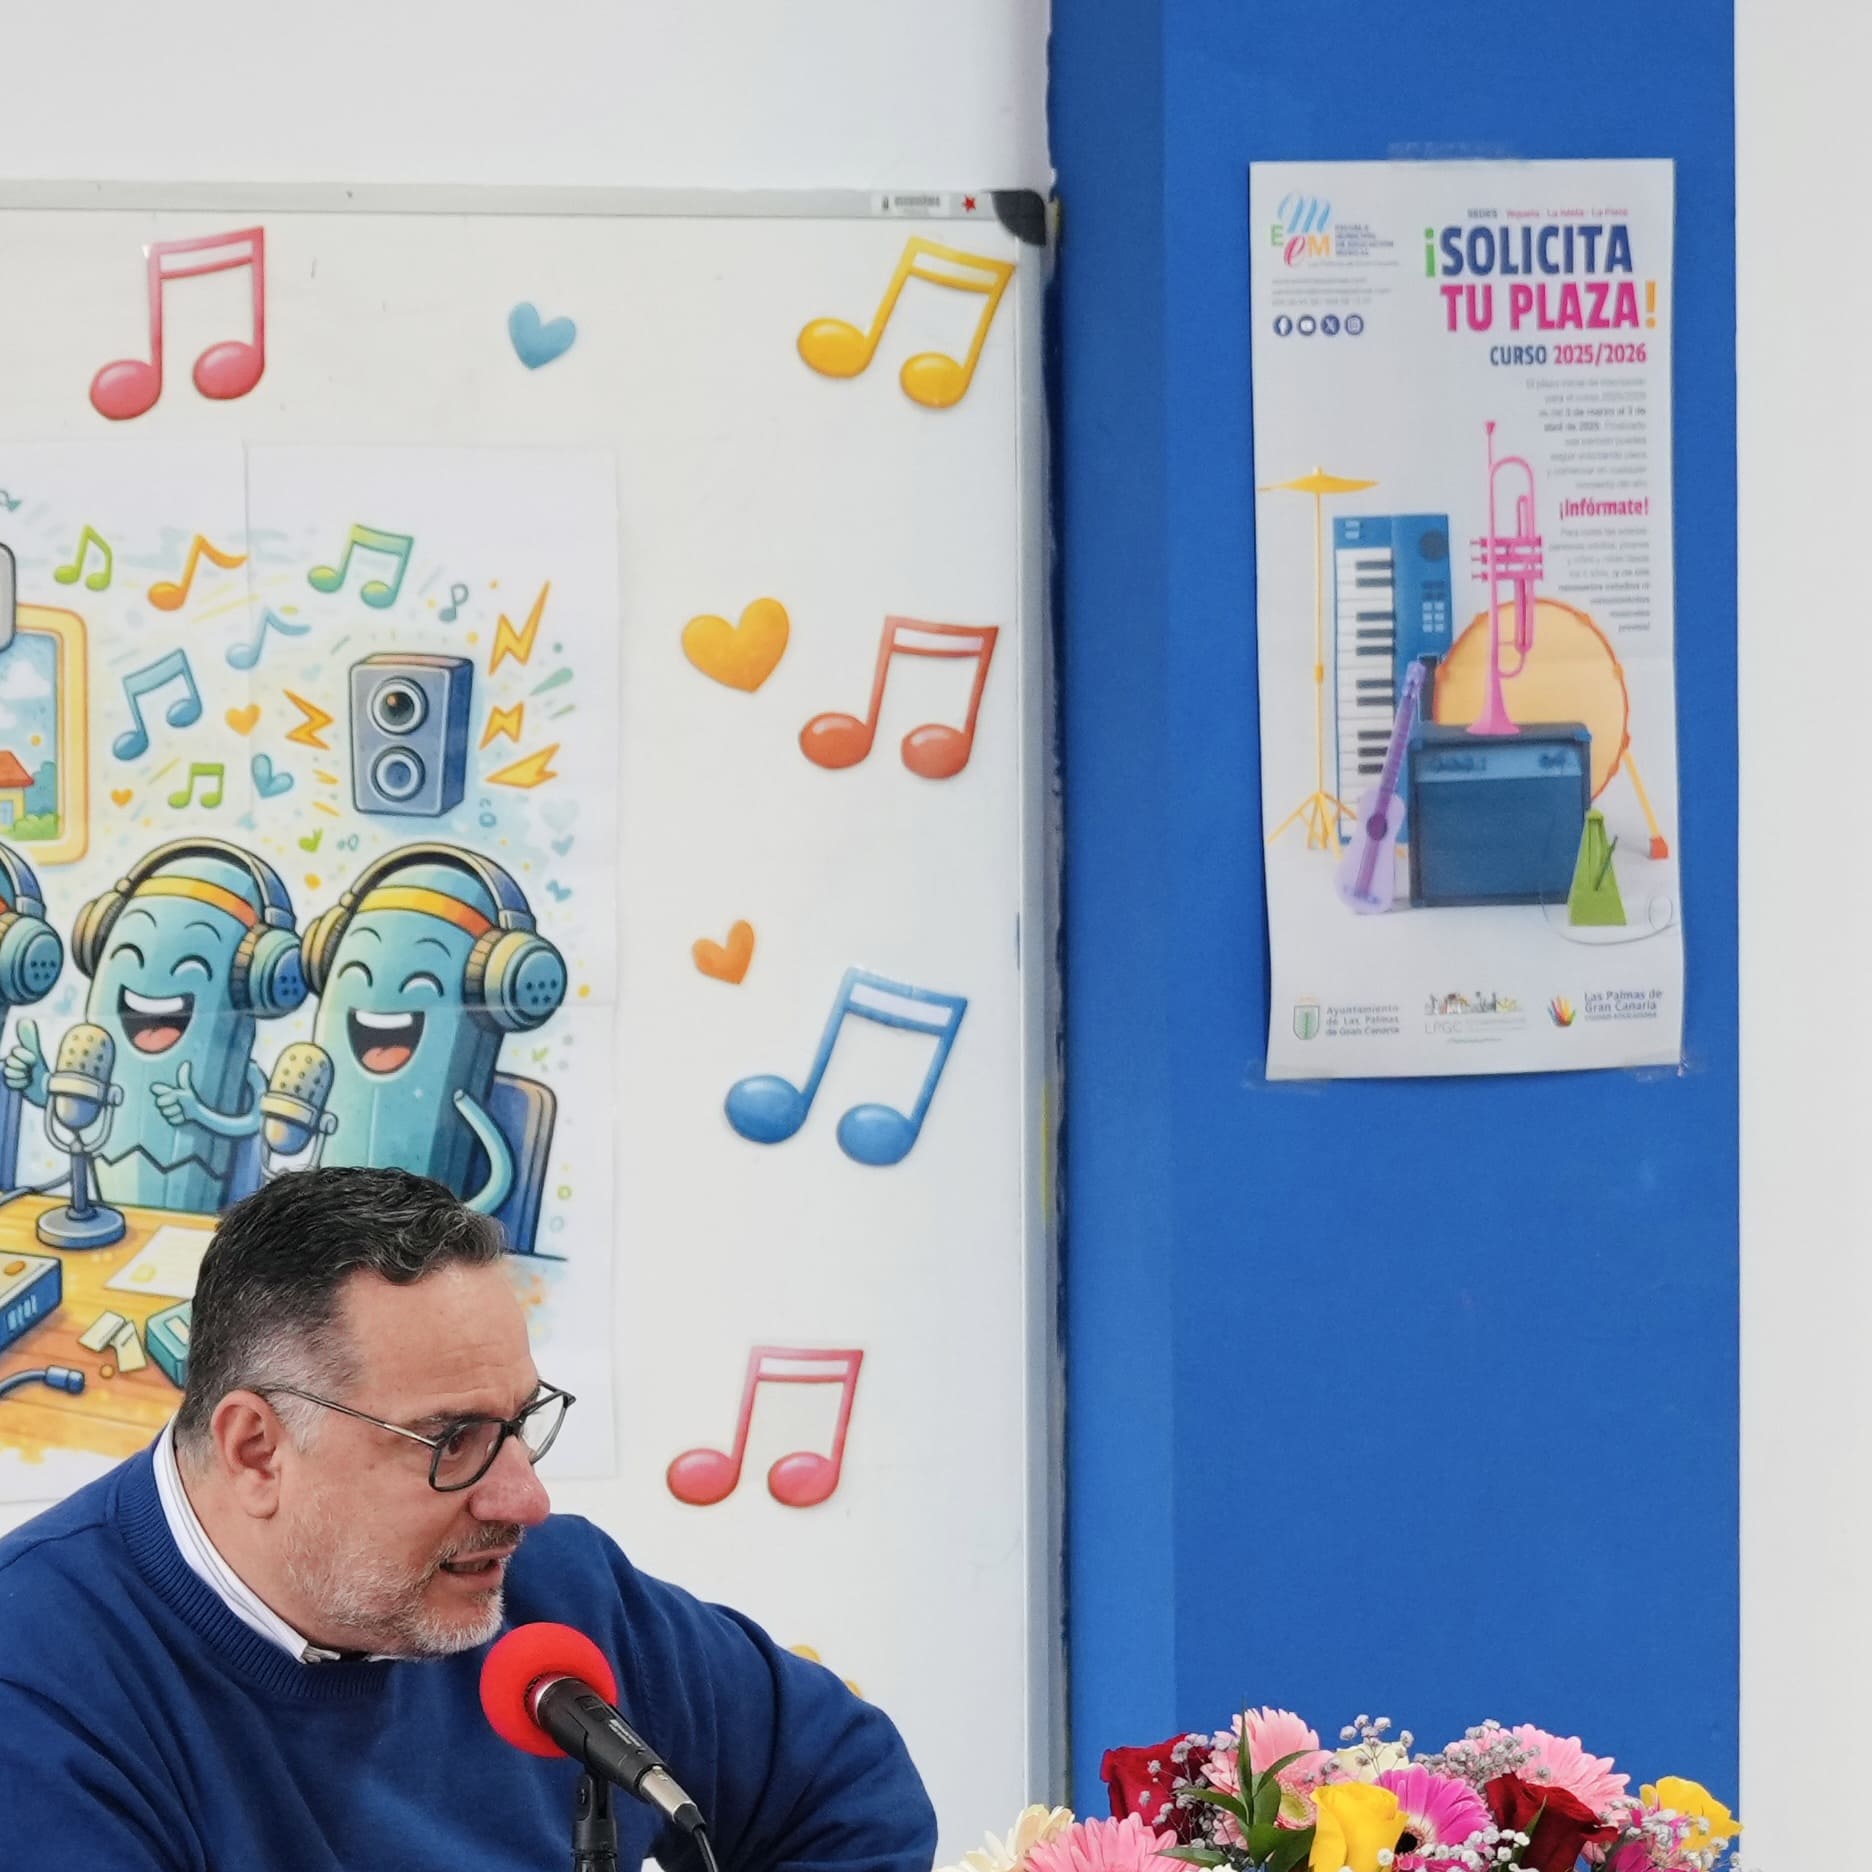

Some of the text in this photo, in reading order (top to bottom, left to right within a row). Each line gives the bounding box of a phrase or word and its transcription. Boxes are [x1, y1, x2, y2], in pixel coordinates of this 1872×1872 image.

[1424, 225, 1634, 278] ¡SOLICITA
[1440, 280, 1658, 332] TU PLAZA!
[1489, 343, 1647, 367] CURSO 2025/2026
[1606, 990, 1646, 1001] Palmas
[1615, 999, 1657, 1012] Canaria
